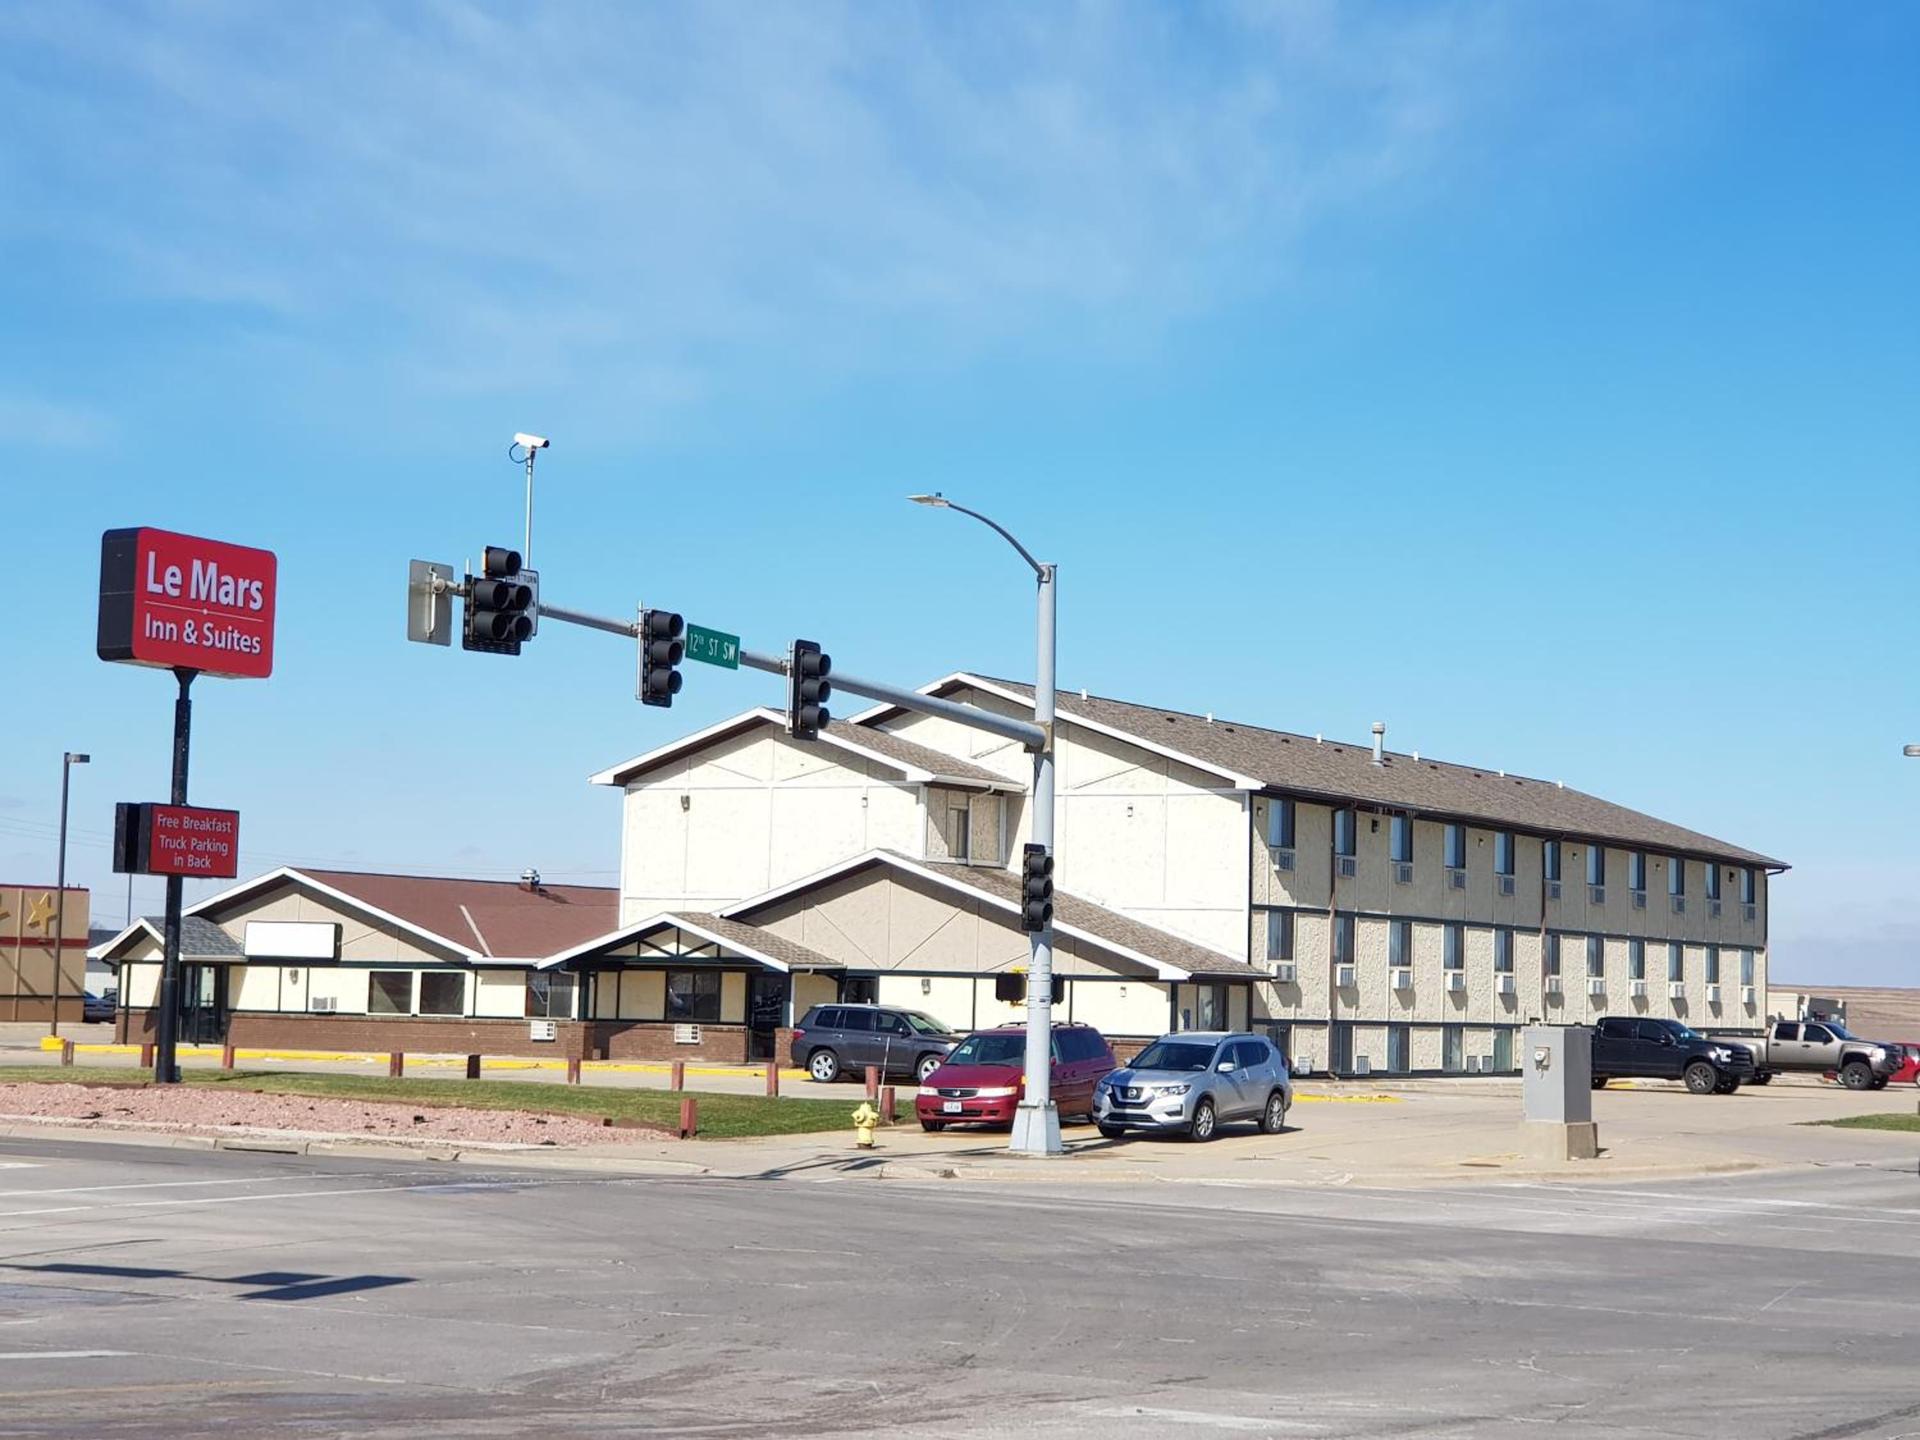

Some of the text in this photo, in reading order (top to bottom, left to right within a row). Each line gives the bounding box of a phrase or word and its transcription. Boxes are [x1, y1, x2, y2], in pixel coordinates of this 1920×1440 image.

[146, 551, 263, 610] Le Mars
[145, 612, 261, 654] Inn & Suites
[708, 638, 719, 657] ST
[723, 642, 736, 661] SW
[157, 814, 231, 833] Free Breakfast
[159, 835, 228, 856] Truck Parking
[174, 853, 211, 869] in Back
